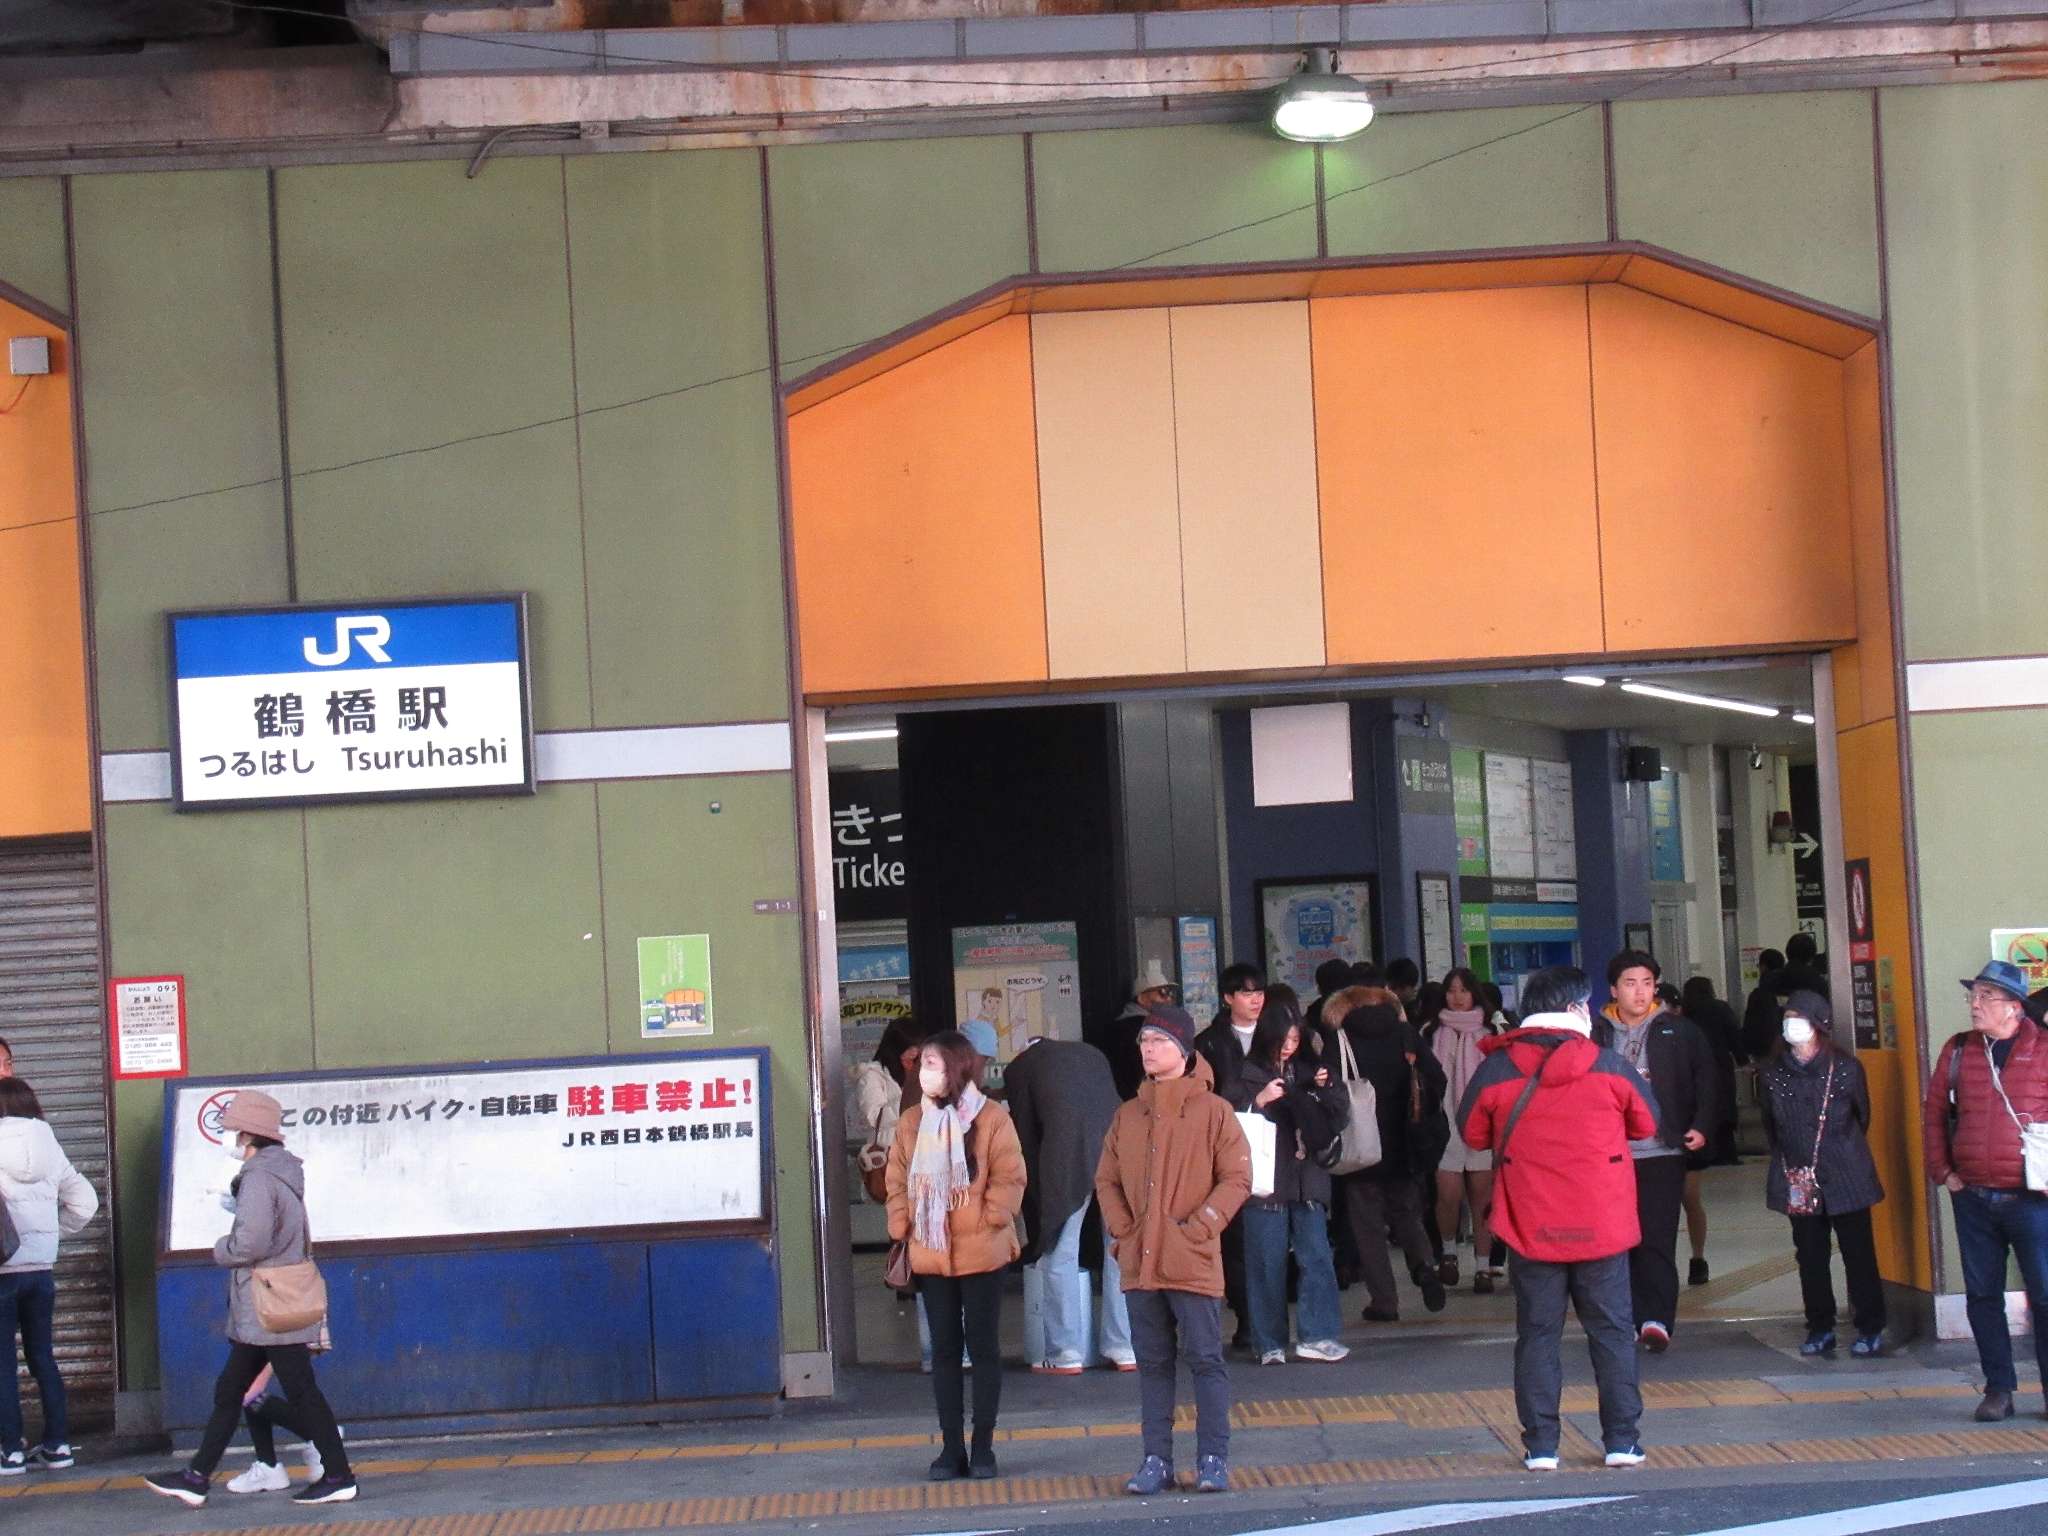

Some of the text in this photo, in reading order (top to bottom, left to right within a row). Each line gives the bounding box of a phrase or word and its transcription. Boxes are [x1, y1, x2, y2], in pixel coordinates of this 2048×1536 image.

[303, 614, 392, 667] JR
[254, 685, 449, 738] 鶴橋駅
[200, 738, 508, 778] つるはし Tsuruhashi
[157, 984, 177, 993] 095
